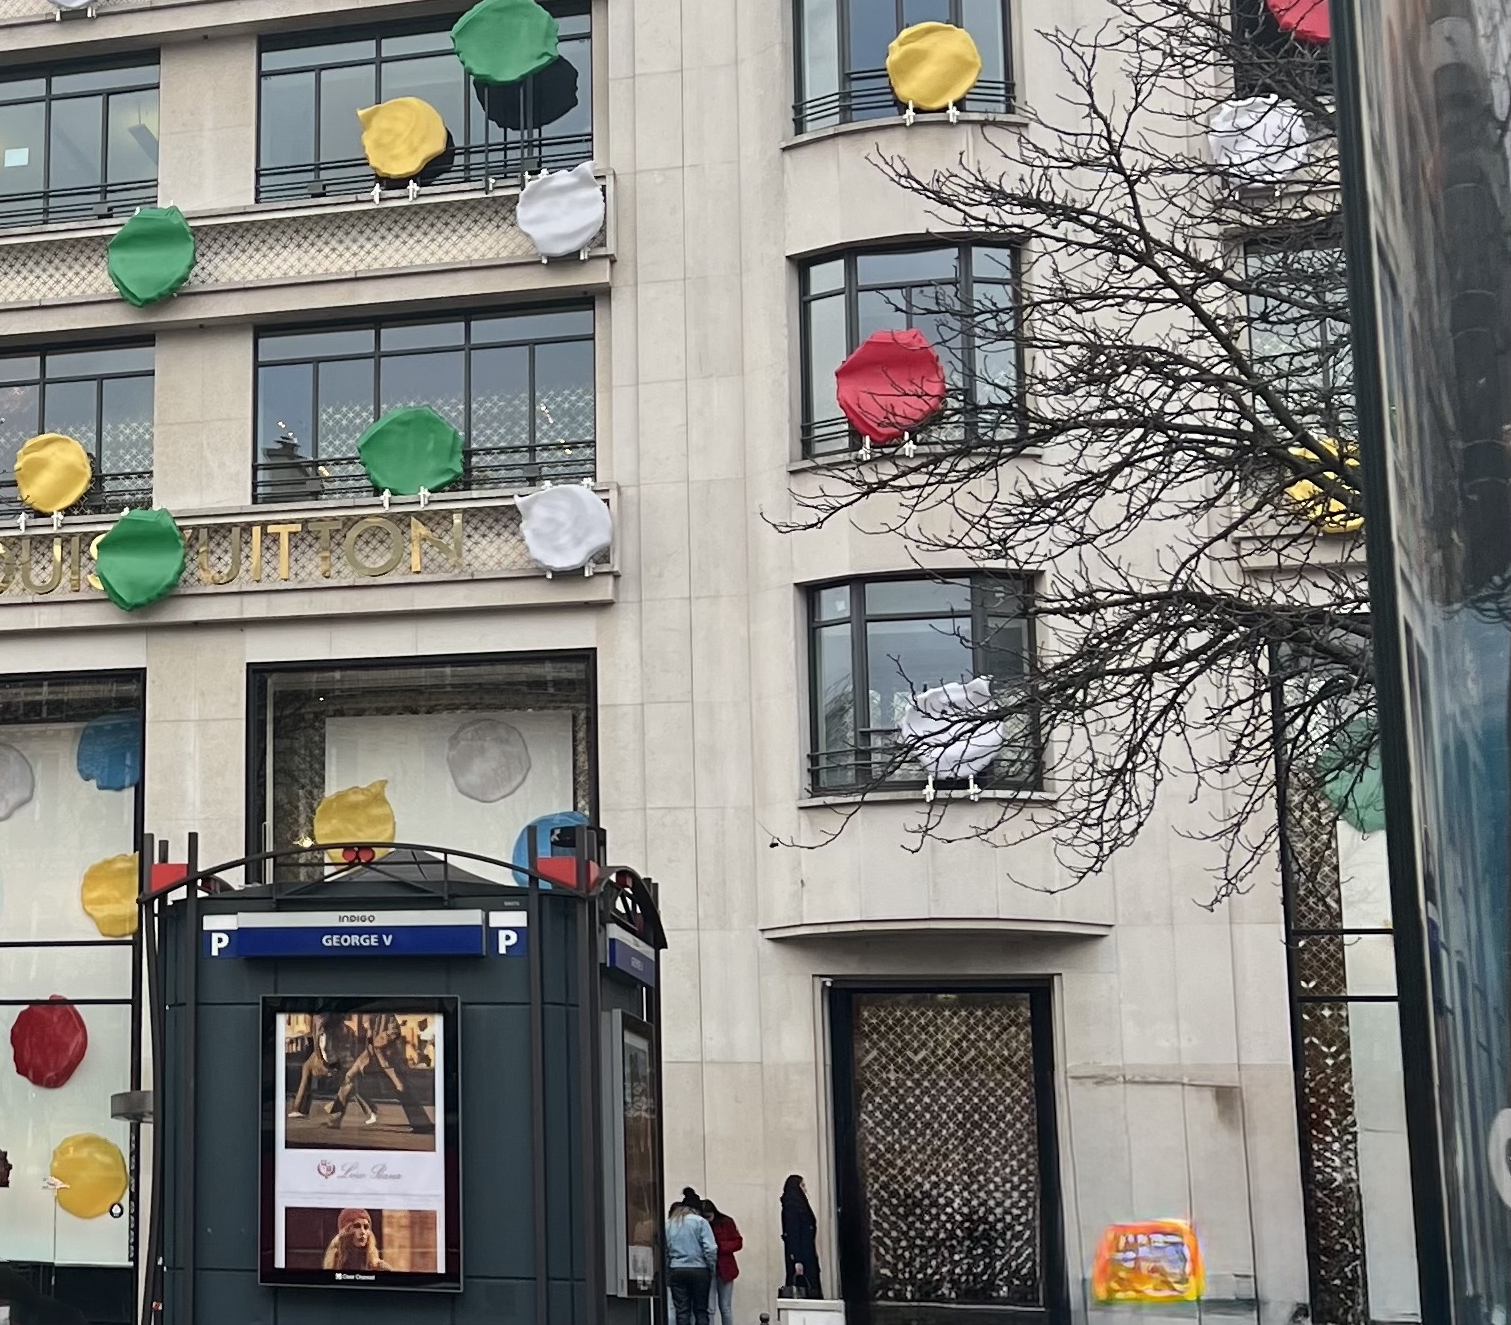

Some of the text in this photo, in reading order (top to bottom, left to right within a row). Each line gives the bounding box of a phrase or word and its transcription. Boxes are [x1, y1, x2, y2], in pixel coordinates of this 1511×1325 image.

[183, 513, 463, 585] UITTON
[338, 914, 376, 924] INDIGO
[211, 932, 230, 957] P
[321, 934, 393, 947] GEORGE V
[498, 929, 518, 955] P
